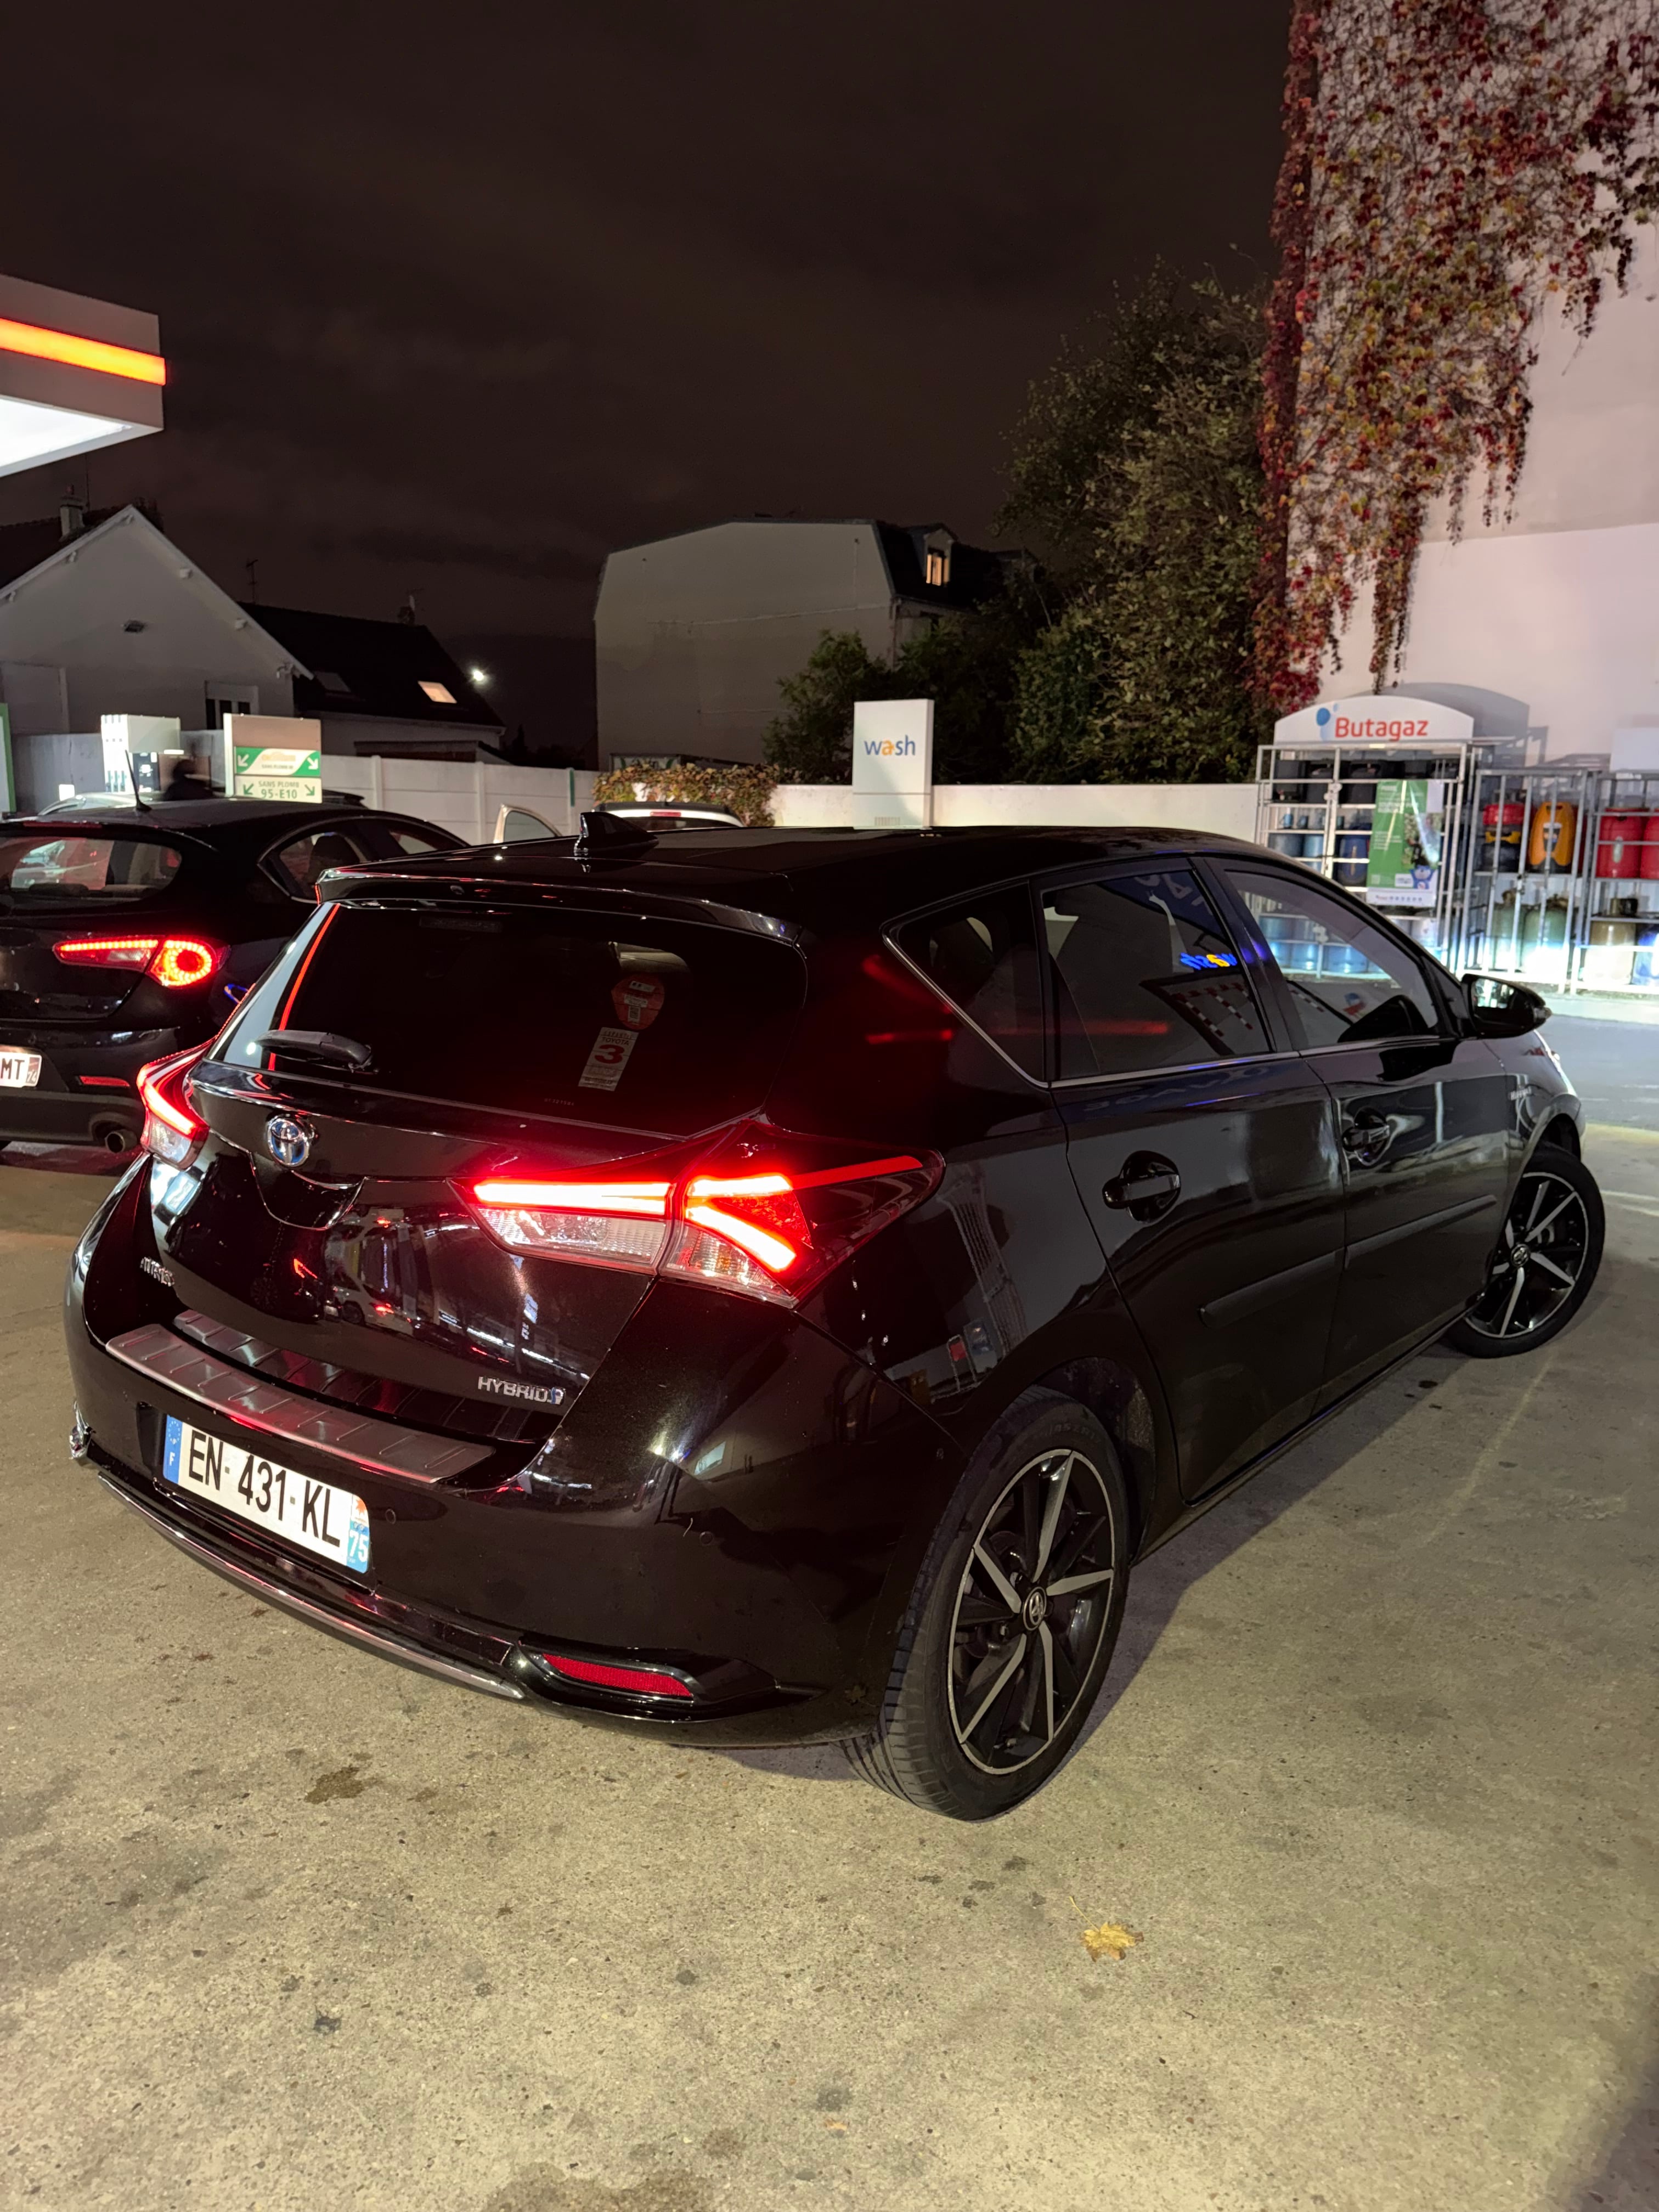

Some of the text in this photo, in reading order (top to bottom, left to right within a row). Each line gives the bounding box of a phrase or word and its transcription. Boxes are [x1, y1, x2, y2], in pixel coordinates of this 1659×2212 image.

[1335, 717, 1429, 742] Butagaz
[864, 734, 915, 756] wash
[261, 789, 297, 799] 95-E10
[601, 1037, 629, 1046] TOYOTA
[595, 1044, 625, 1064] 3
[1, 1058, 25, 1080] MT
[478, 1376, 548, 1403] HYBRID
[169, 1452, 176, 1466] F
[349, 1529, 369, 1562] 75
